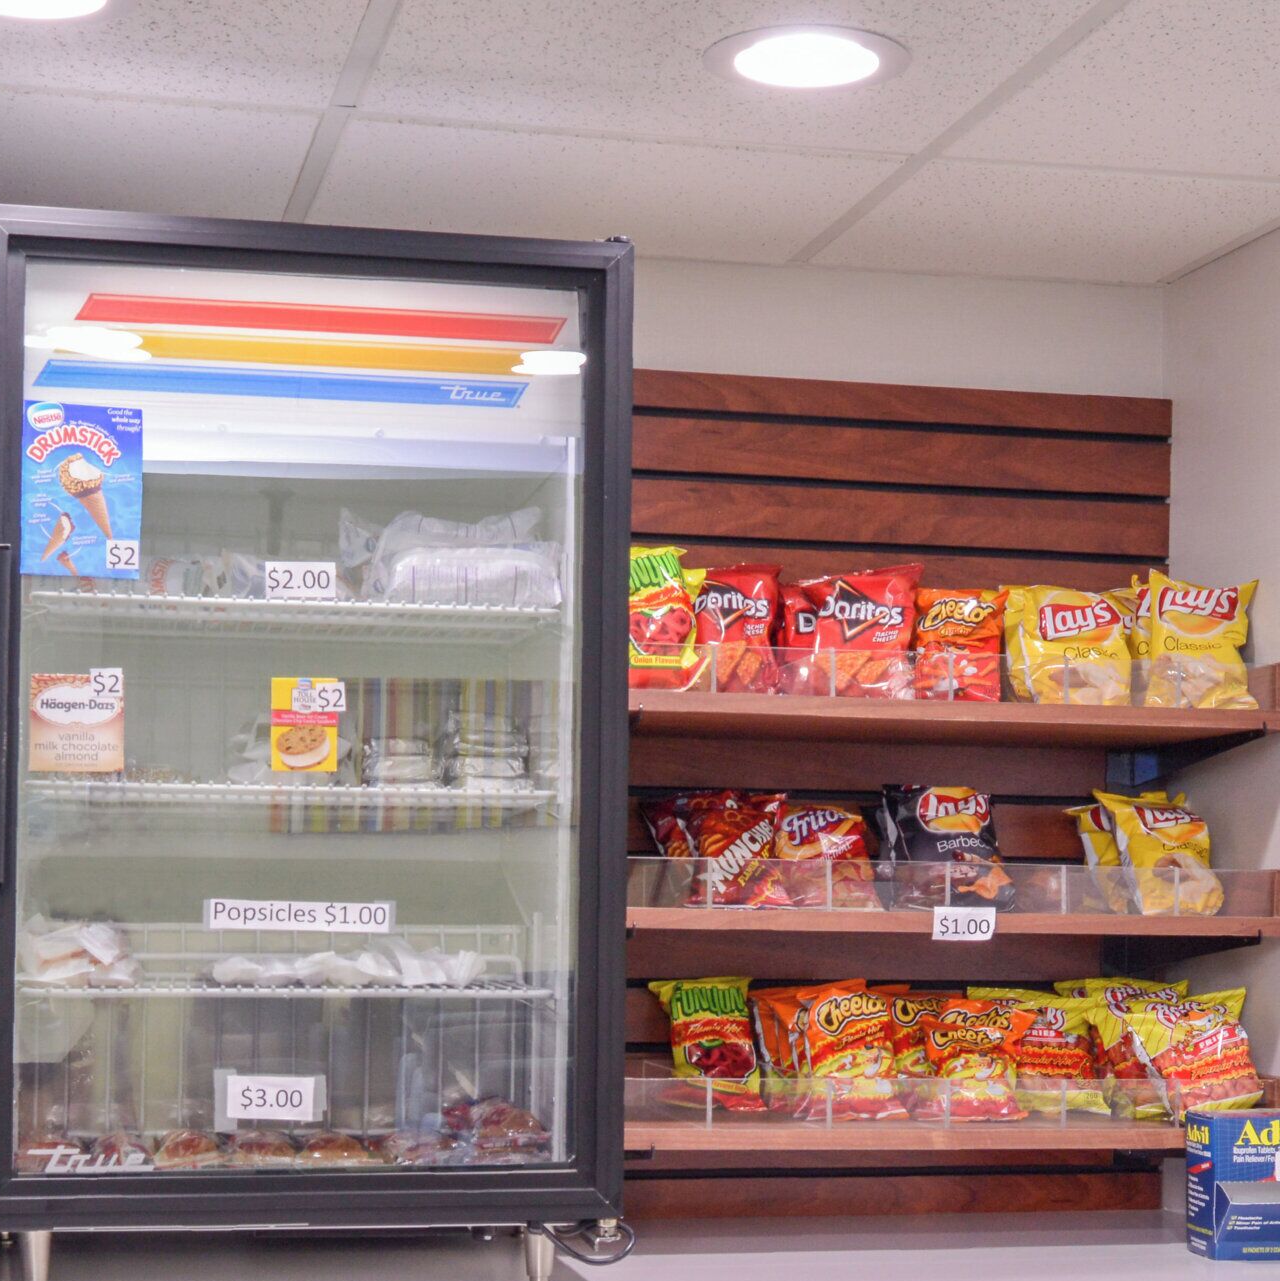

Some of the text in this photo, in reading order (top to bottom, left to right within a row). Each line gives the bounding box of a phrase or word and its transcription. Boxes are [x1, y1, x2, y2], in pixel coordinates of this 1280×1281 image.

[28, 425, 121, 465] DRUMSTICK
[108, 544, 136, 568] $2
[267, 568, 331, 591] $2.00
[694, 588, 770, 619] Doritos
[821, 595, 904, 625] Doritos
[1160, 587, 1238, 616] Lay's
[1164, 636, 1223, 651] Classic
[93, 671, 120, 696] $2
[40, 698, 116, 713] Häagen-Dazs
[318, 686, 344, 711] $2
[34, 741, 119, 752] milk chocolate
[58, 731, 96, 741] vanilla
[54, 751, 99, 761] almond
[212, 900, 387, 927] Popsicles $1.00
[939, 916, 991, 937] $1.00
[239, 1085, 304, 1110] $3.00
[1232, 1155, 1246, 1163] Pain
